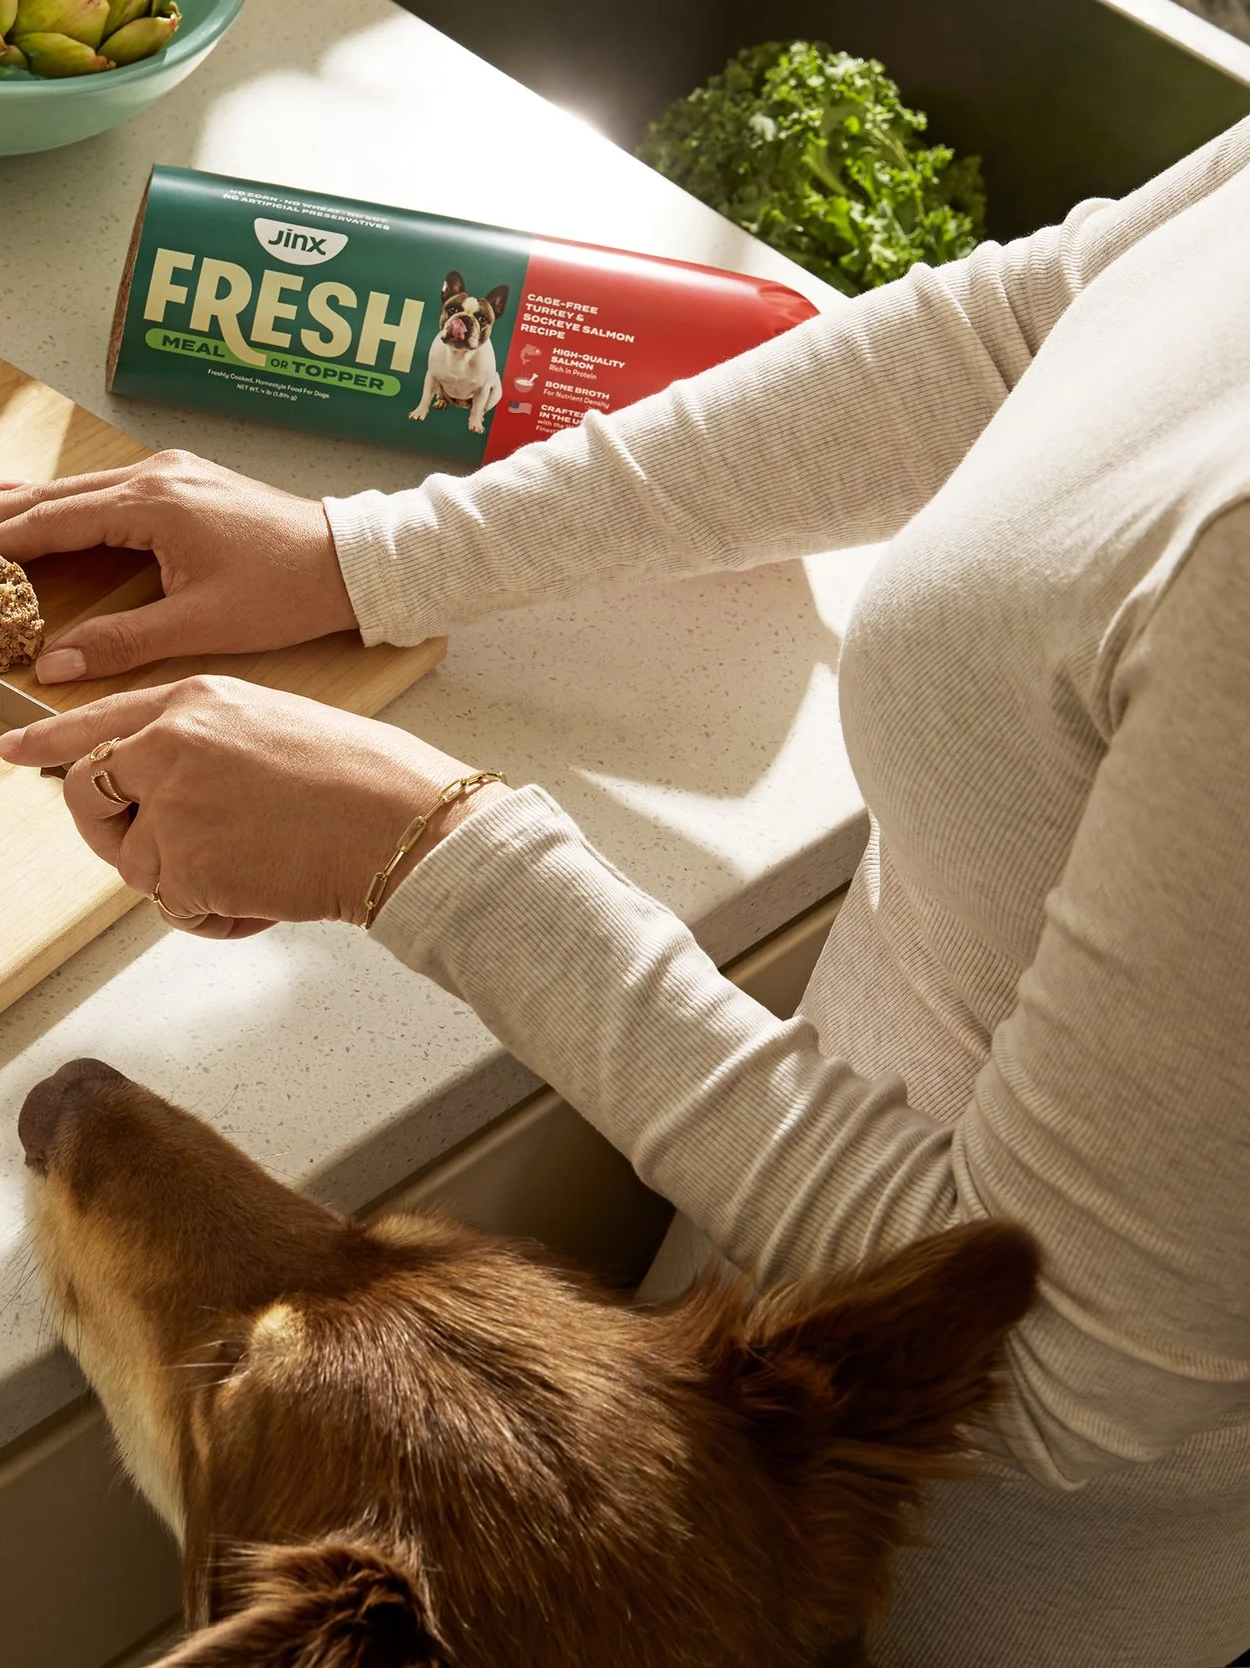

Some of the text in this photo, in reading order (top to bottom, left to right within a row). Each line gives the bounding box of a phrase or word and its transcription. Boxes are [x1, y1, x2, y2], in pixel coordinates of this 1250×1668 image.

[247, 192, 278, 202] CORN
[240, 198, 300, 212] ARTIFICIAL
[301, 209, 391, 231] PRESERVATIVES
[143, 248, 425, 374] FRESH
[525, 303, 585, 322] TURKEY &
[527, 293, 599, 315] CAGE-FREE
[520, 323, 566, 340] RECIPE
[522, 313, 635, 343] SOCKEYE SALMON
[161, 334, 385, 391] MEAL OR TOPPER
[550, 356, 595, 371] SALMON
[552, 347, 626, 369] HIGH-QUALITY
[548, 363, 597, 380] Rich in Protein
[207, 368, 330, 400] Freshly Cooked, Homestyle Food For Dogs
[236, 383, 248, 391] NET
[545, 380, 610, 400] BONE BROTH
[543, 388, 610, 409] For Nutrient Density
[539, 411, 550, 419] IN
[551, 414, 572, 425] THE
